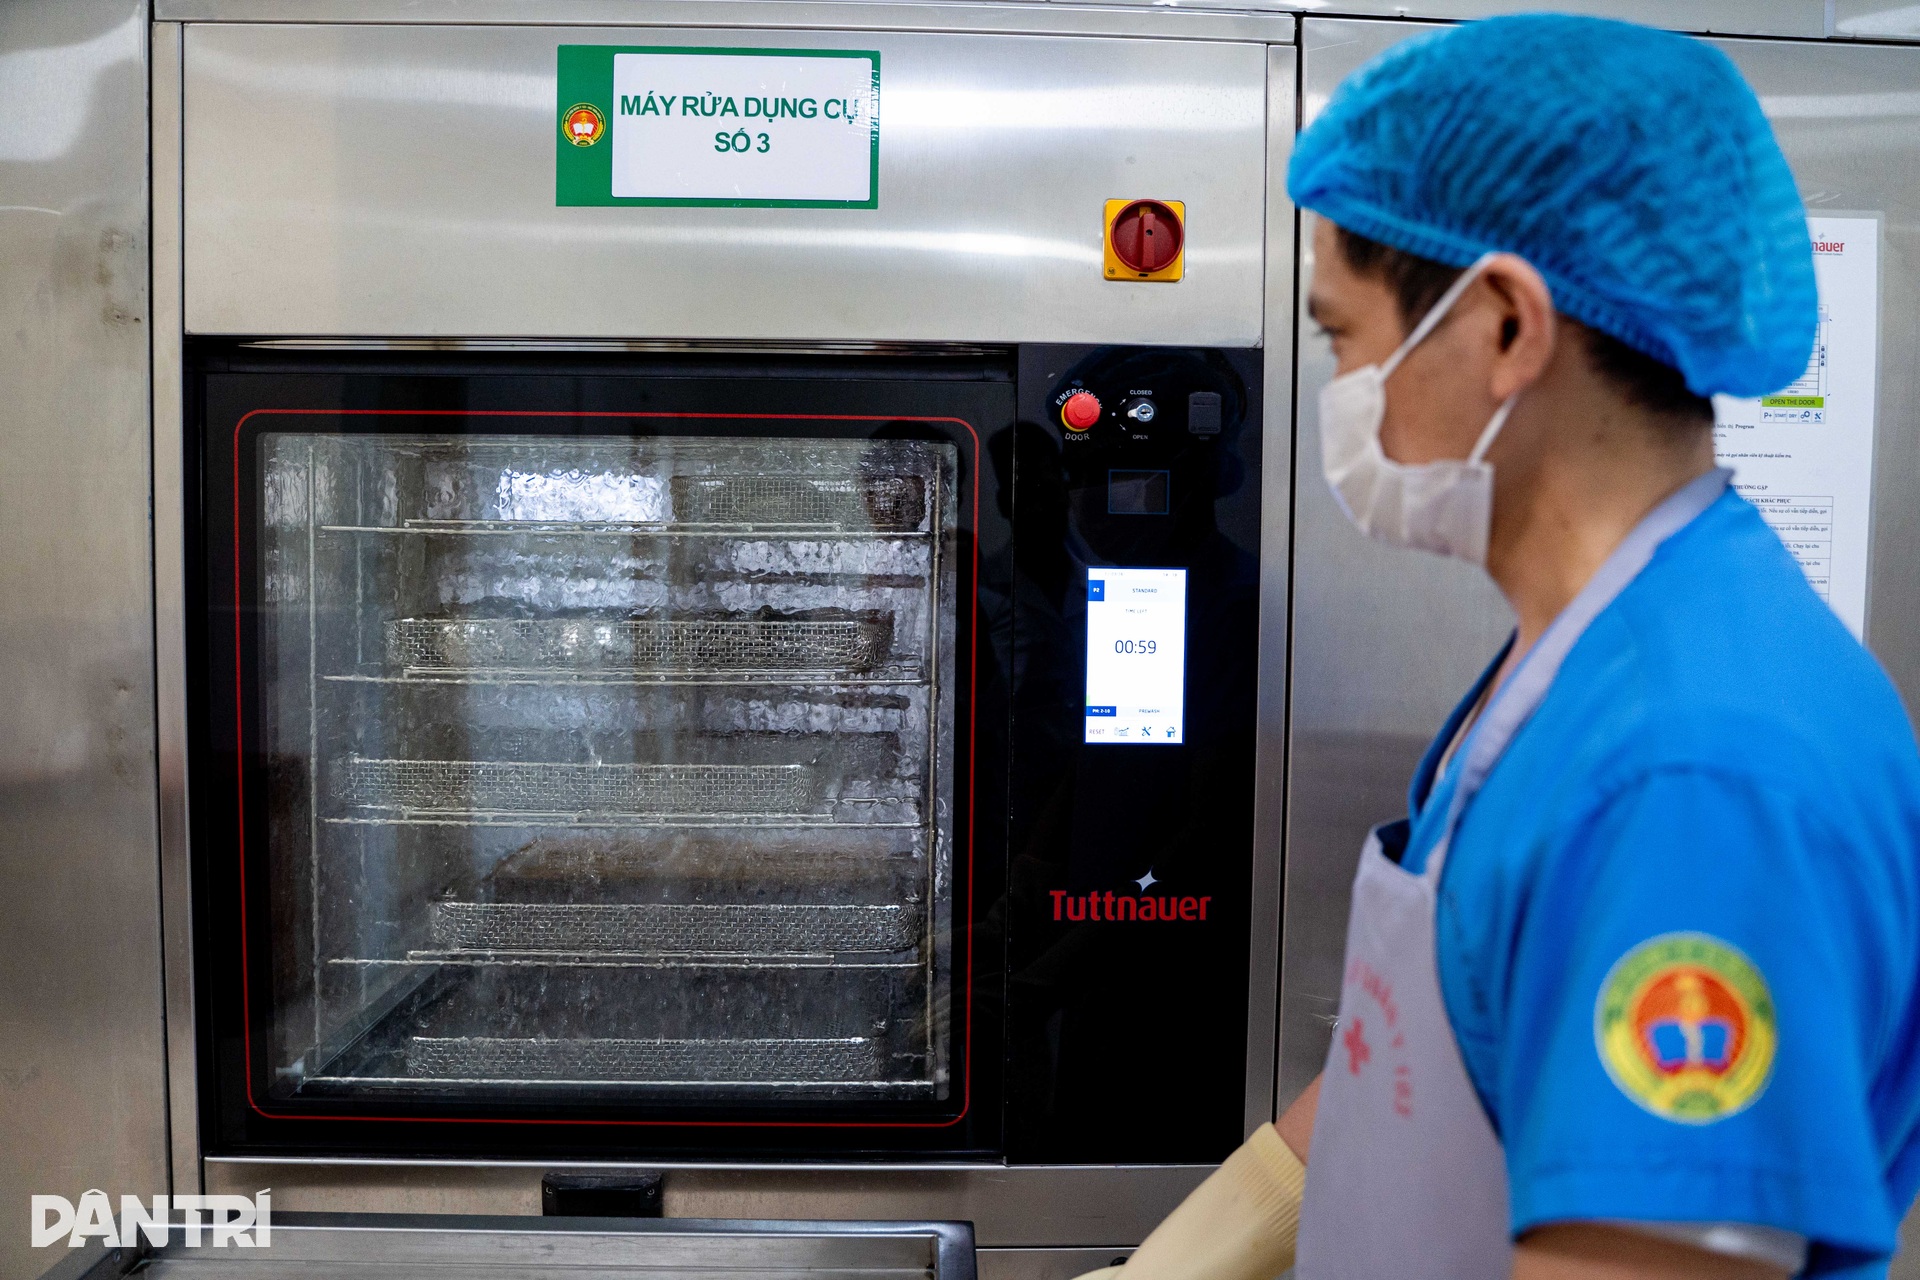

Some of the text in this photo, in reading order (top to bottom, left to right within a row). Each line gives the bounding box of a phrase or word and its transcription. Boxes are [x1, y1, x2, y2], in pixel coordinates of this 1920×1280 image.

[620, 90, 676, 116] MÁY
[682, 91, 739, 117] RỬA
[744, 97, 819, 123] DỤNG
[823, 98, 859, 125] CỤ
[714, 128, 770, 153] SỐ 3
[1787, 398, 1797, 406] THE
[1065, 432, 1090, 441] DOOR
[1115, 640, 1156, 654] 00:59
[1049, 890, 1212, 921] Tuttnauer
